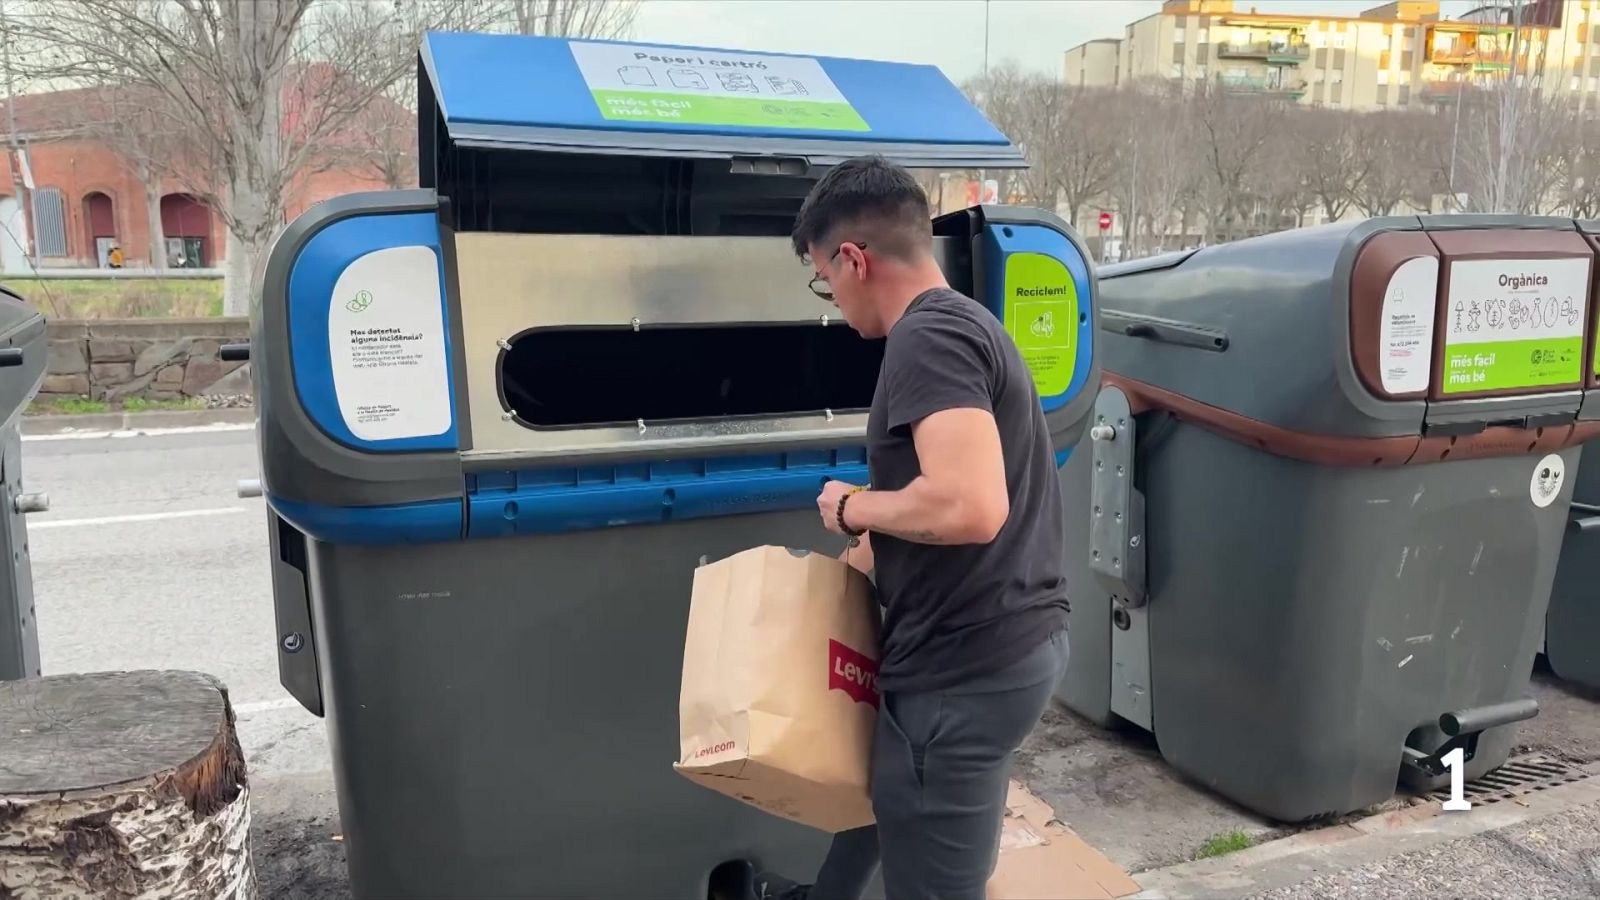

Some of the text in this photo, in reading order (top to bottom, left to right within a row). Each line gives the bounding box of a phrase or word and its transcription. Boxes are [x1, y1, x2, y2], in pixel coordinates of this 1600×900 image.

[633, 52, 695, 67] Paper
[708, 58, 769, 70] cartró
[1498, 272, 1548, 290] Orgànica
[1016, 285, 1067, 297] Reciclem!
[1450, 352, 1496, 368] més fàcil
[1449, 369, 1486, 384] més bé
